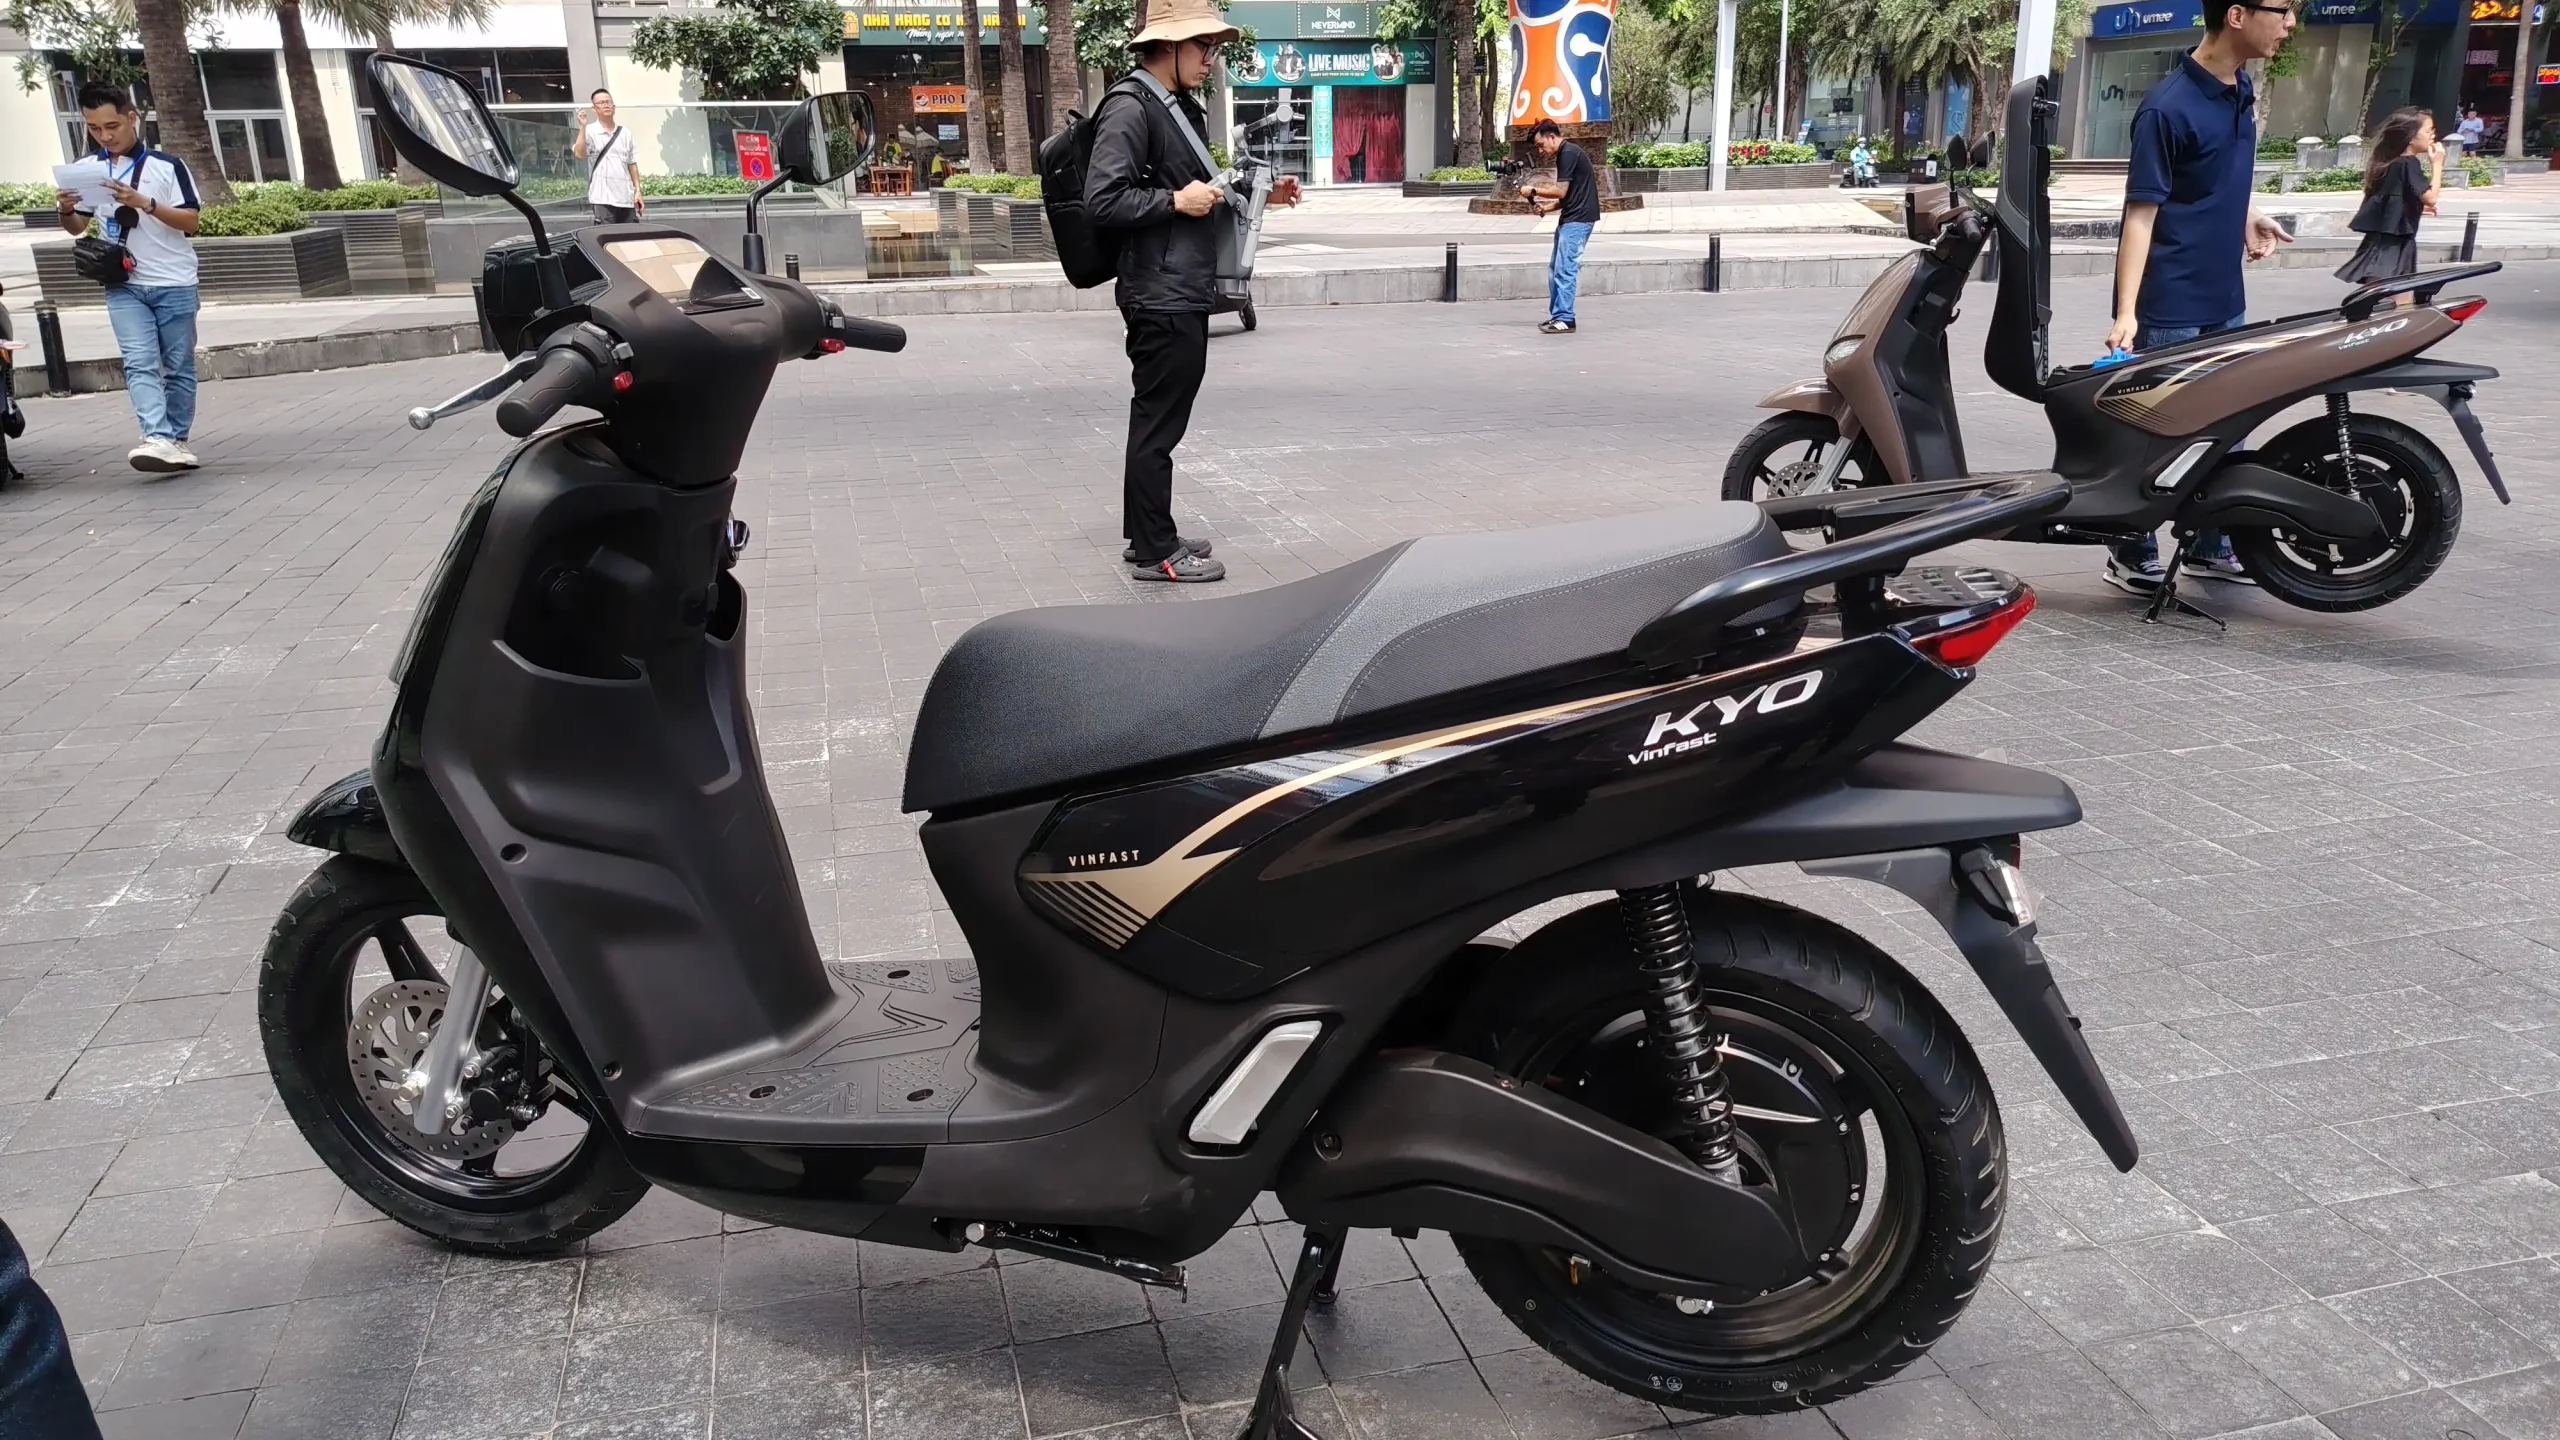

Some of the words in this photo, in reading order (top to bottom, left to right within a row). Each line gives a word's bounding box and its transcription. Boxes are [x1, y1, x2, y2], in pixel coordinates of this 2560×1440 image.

[863, 10, 890, 27] NHÀ
[895, 10, 931, 27] HÀNG
[2142, 12, 2173, 24] umee
[2321, 5, 2356, 15] umee
[1311, 20, 1356, 29] NEVERMIND
[1309, 54, 1332, 72] LIVE
[1333, 54, 1370, 72] MUSIC
[2344, 318, 2409, 344] KYO
[2117, 384, 2150, 395] VINFAST
[1643, 669, 1824, 747] KYO
[1068, 850, 1140, 867] VINFAST
